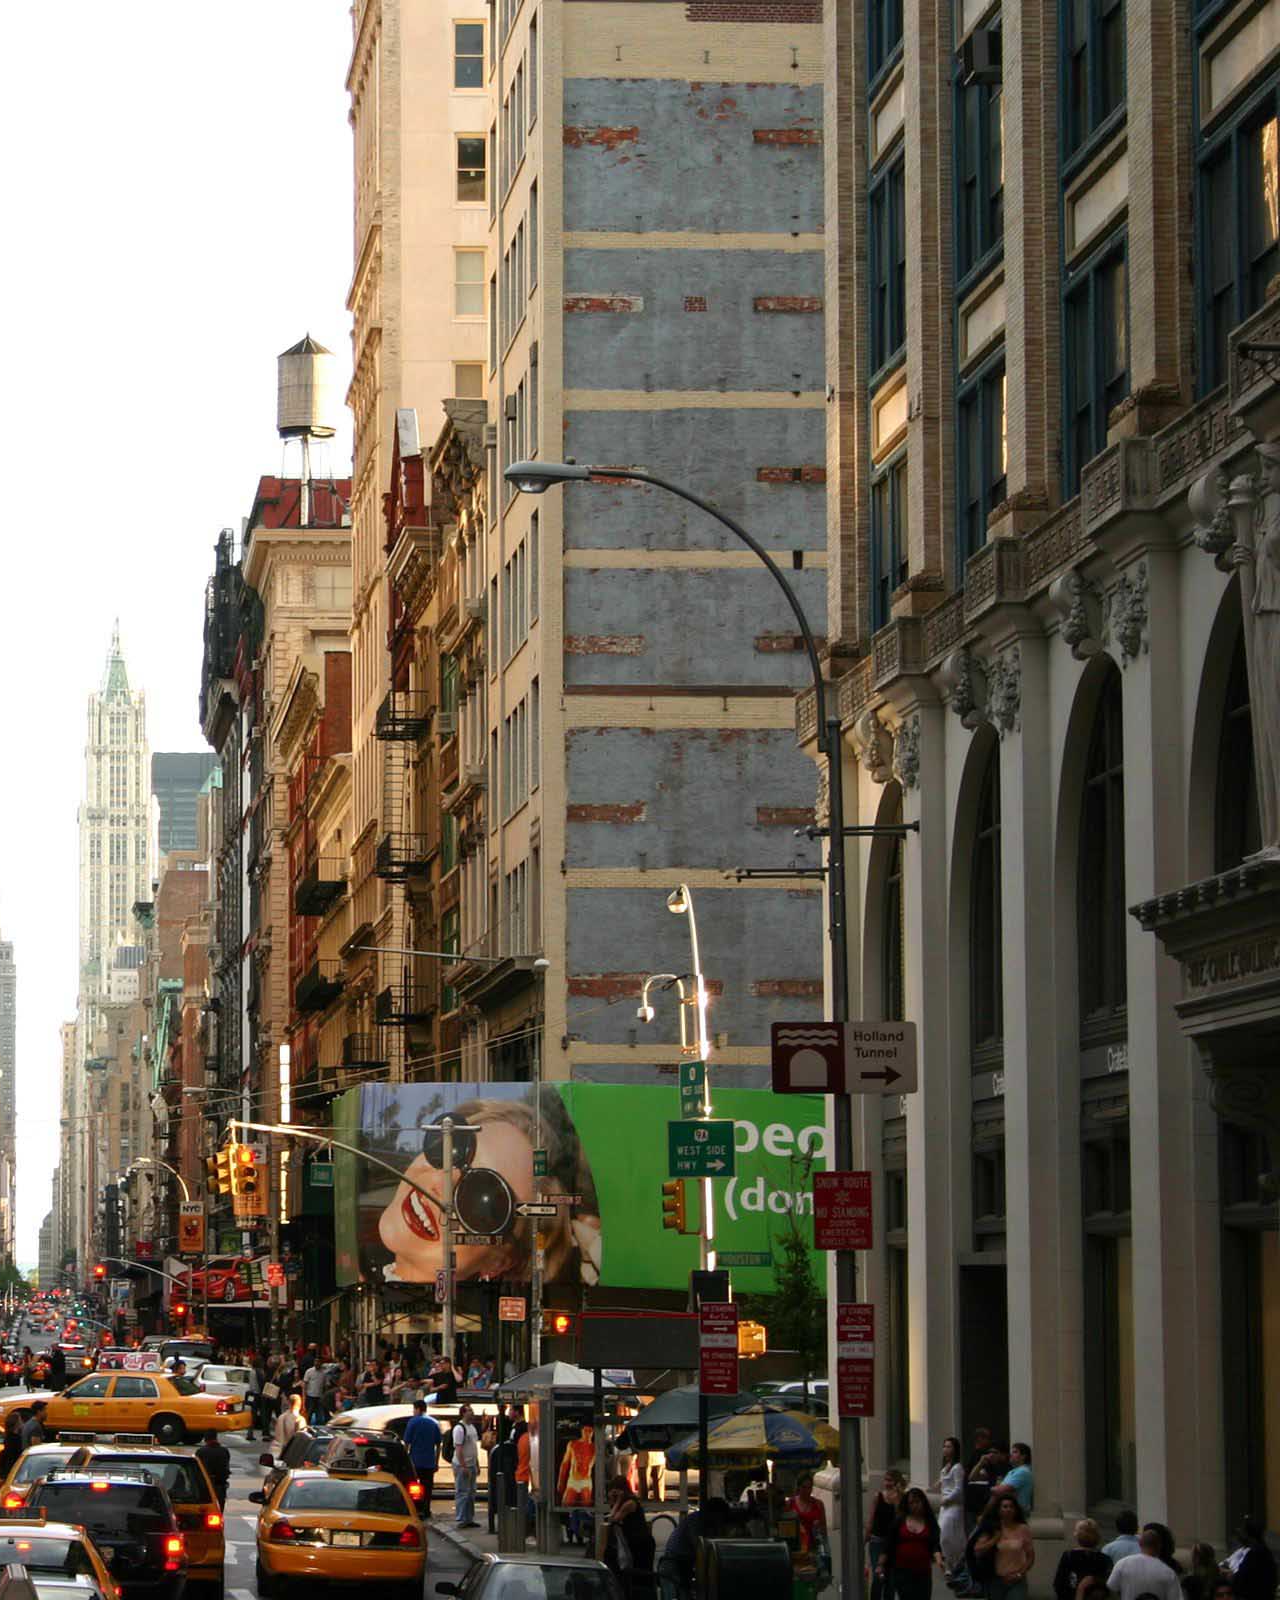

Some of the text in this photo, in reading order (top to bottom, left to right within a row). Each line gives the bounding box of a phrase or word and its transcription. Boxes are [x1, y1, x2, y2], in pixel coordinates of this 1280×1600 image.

[854, 1031, 904, 1042] Holland
[855, 1047, 897, 1058] Tunnel
[677, 1145, 726, 1156] WEST SIDE
[677, 1160, 697, 1170] HWY
[832, 1207, 869, 1218] STANDING
